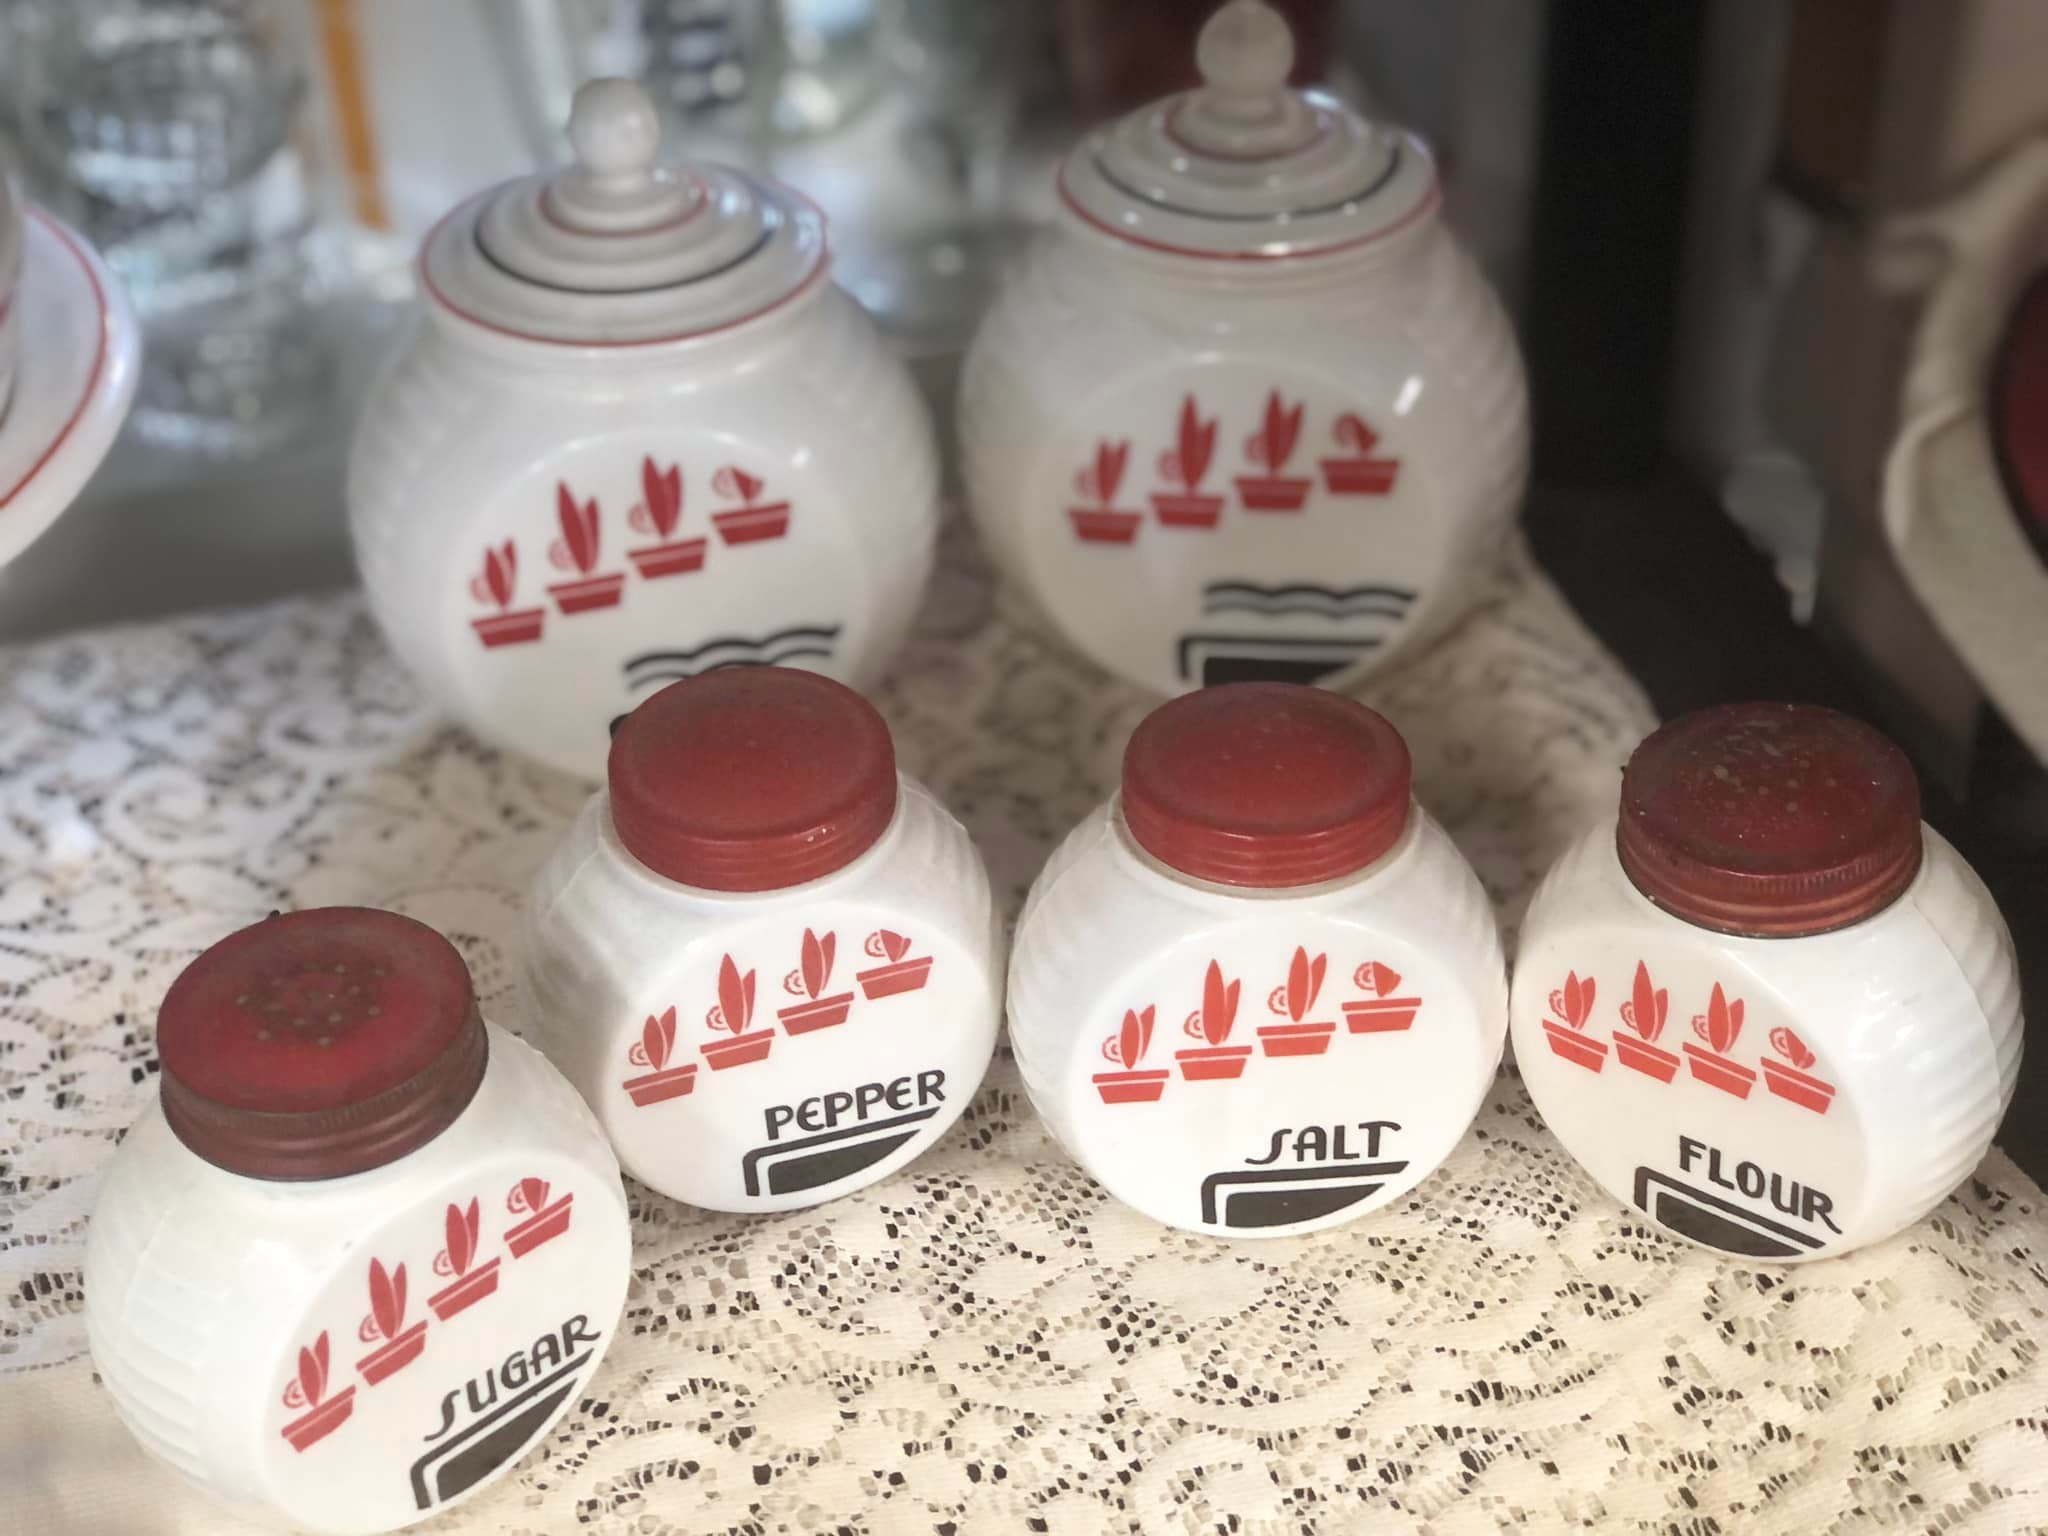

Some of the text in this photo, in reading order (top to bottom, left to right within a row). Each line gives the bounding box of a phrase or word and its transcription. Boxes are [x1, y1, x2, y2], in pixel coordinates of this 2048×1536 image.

[764, 1069, 946, 1141] PEPPER
[1244, 1120, 1402, 1165] SALT
[1678, 1134, 1844, 1235] FLOUR
[423, 1314, 602, 1442] SUGAR
